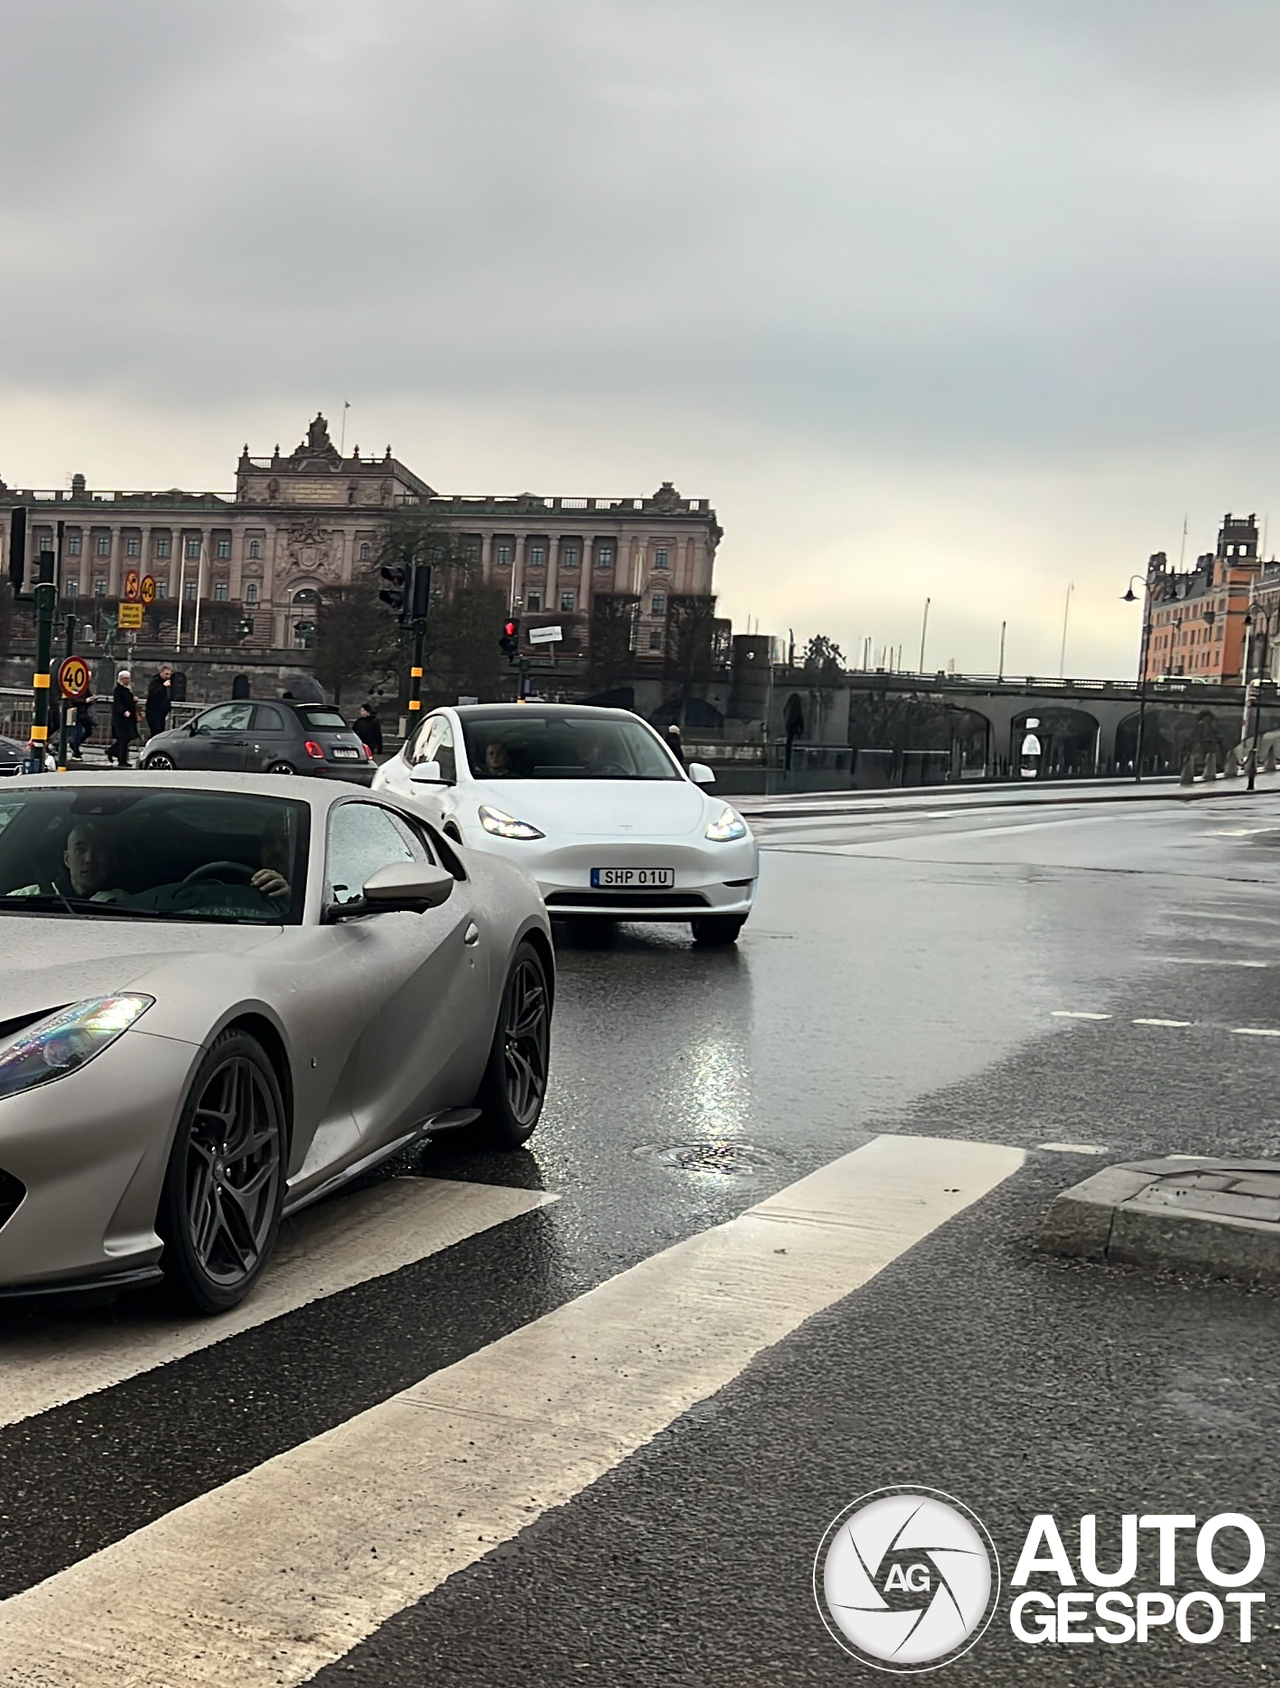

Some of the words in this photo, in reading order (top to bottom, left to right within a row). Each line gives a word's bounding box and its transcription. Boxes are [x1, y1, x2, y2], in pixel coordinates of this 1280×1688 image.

[142, 581, 153, 598] 40
[63, 666, 85, 688] 40
[605, 870, 634, 884] SHP
[638, 870, 667, 884] 01U
